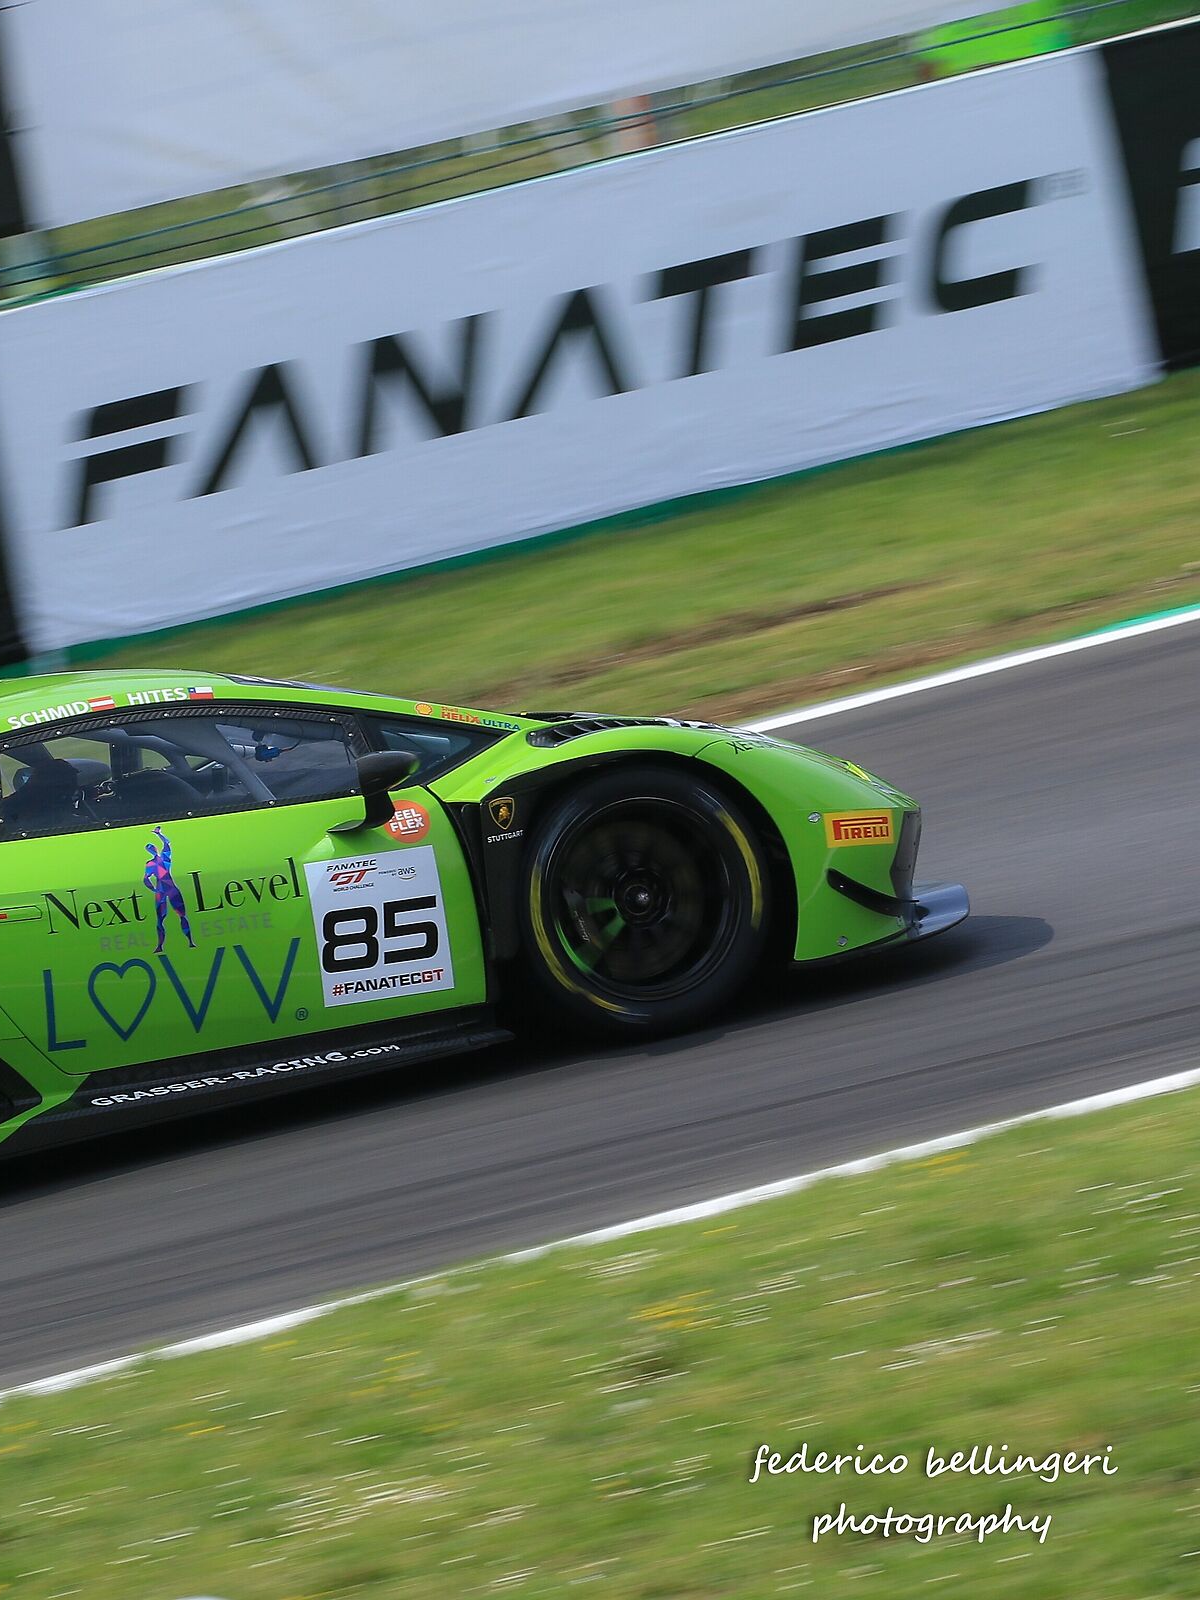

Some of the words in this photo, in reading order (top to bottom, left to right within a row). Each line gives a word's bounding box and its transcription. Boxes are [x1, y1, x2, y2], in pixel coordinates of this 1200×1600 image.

[56, 178, 1044, 530] FANATEC
[126, 687, 188, 706] HITES
[6, 701, 90, 730] SCHMID
[441, 711, 481, 725] HELIX
[481, 718, 521, 731] ULTRA
[388, 808, 422, 823] EEL
[390, 816, 425, 832] FLEX
[487, 829, 524, 844] STUTTGART
[832, 816, 890, 841] PIRELLI
[326, 859, 377, 872] FANATEC
[398, 866, 416, 876] aws
[41, 889, 147, 935] Next
[187, 856, 304, 913] Level
[100, 931, 150, 951] REAL
[200, 912, 273, 938] ESTATE
[322, 895, 439, 974] 85
[332, 968, 445, 997] #FANATECGT
